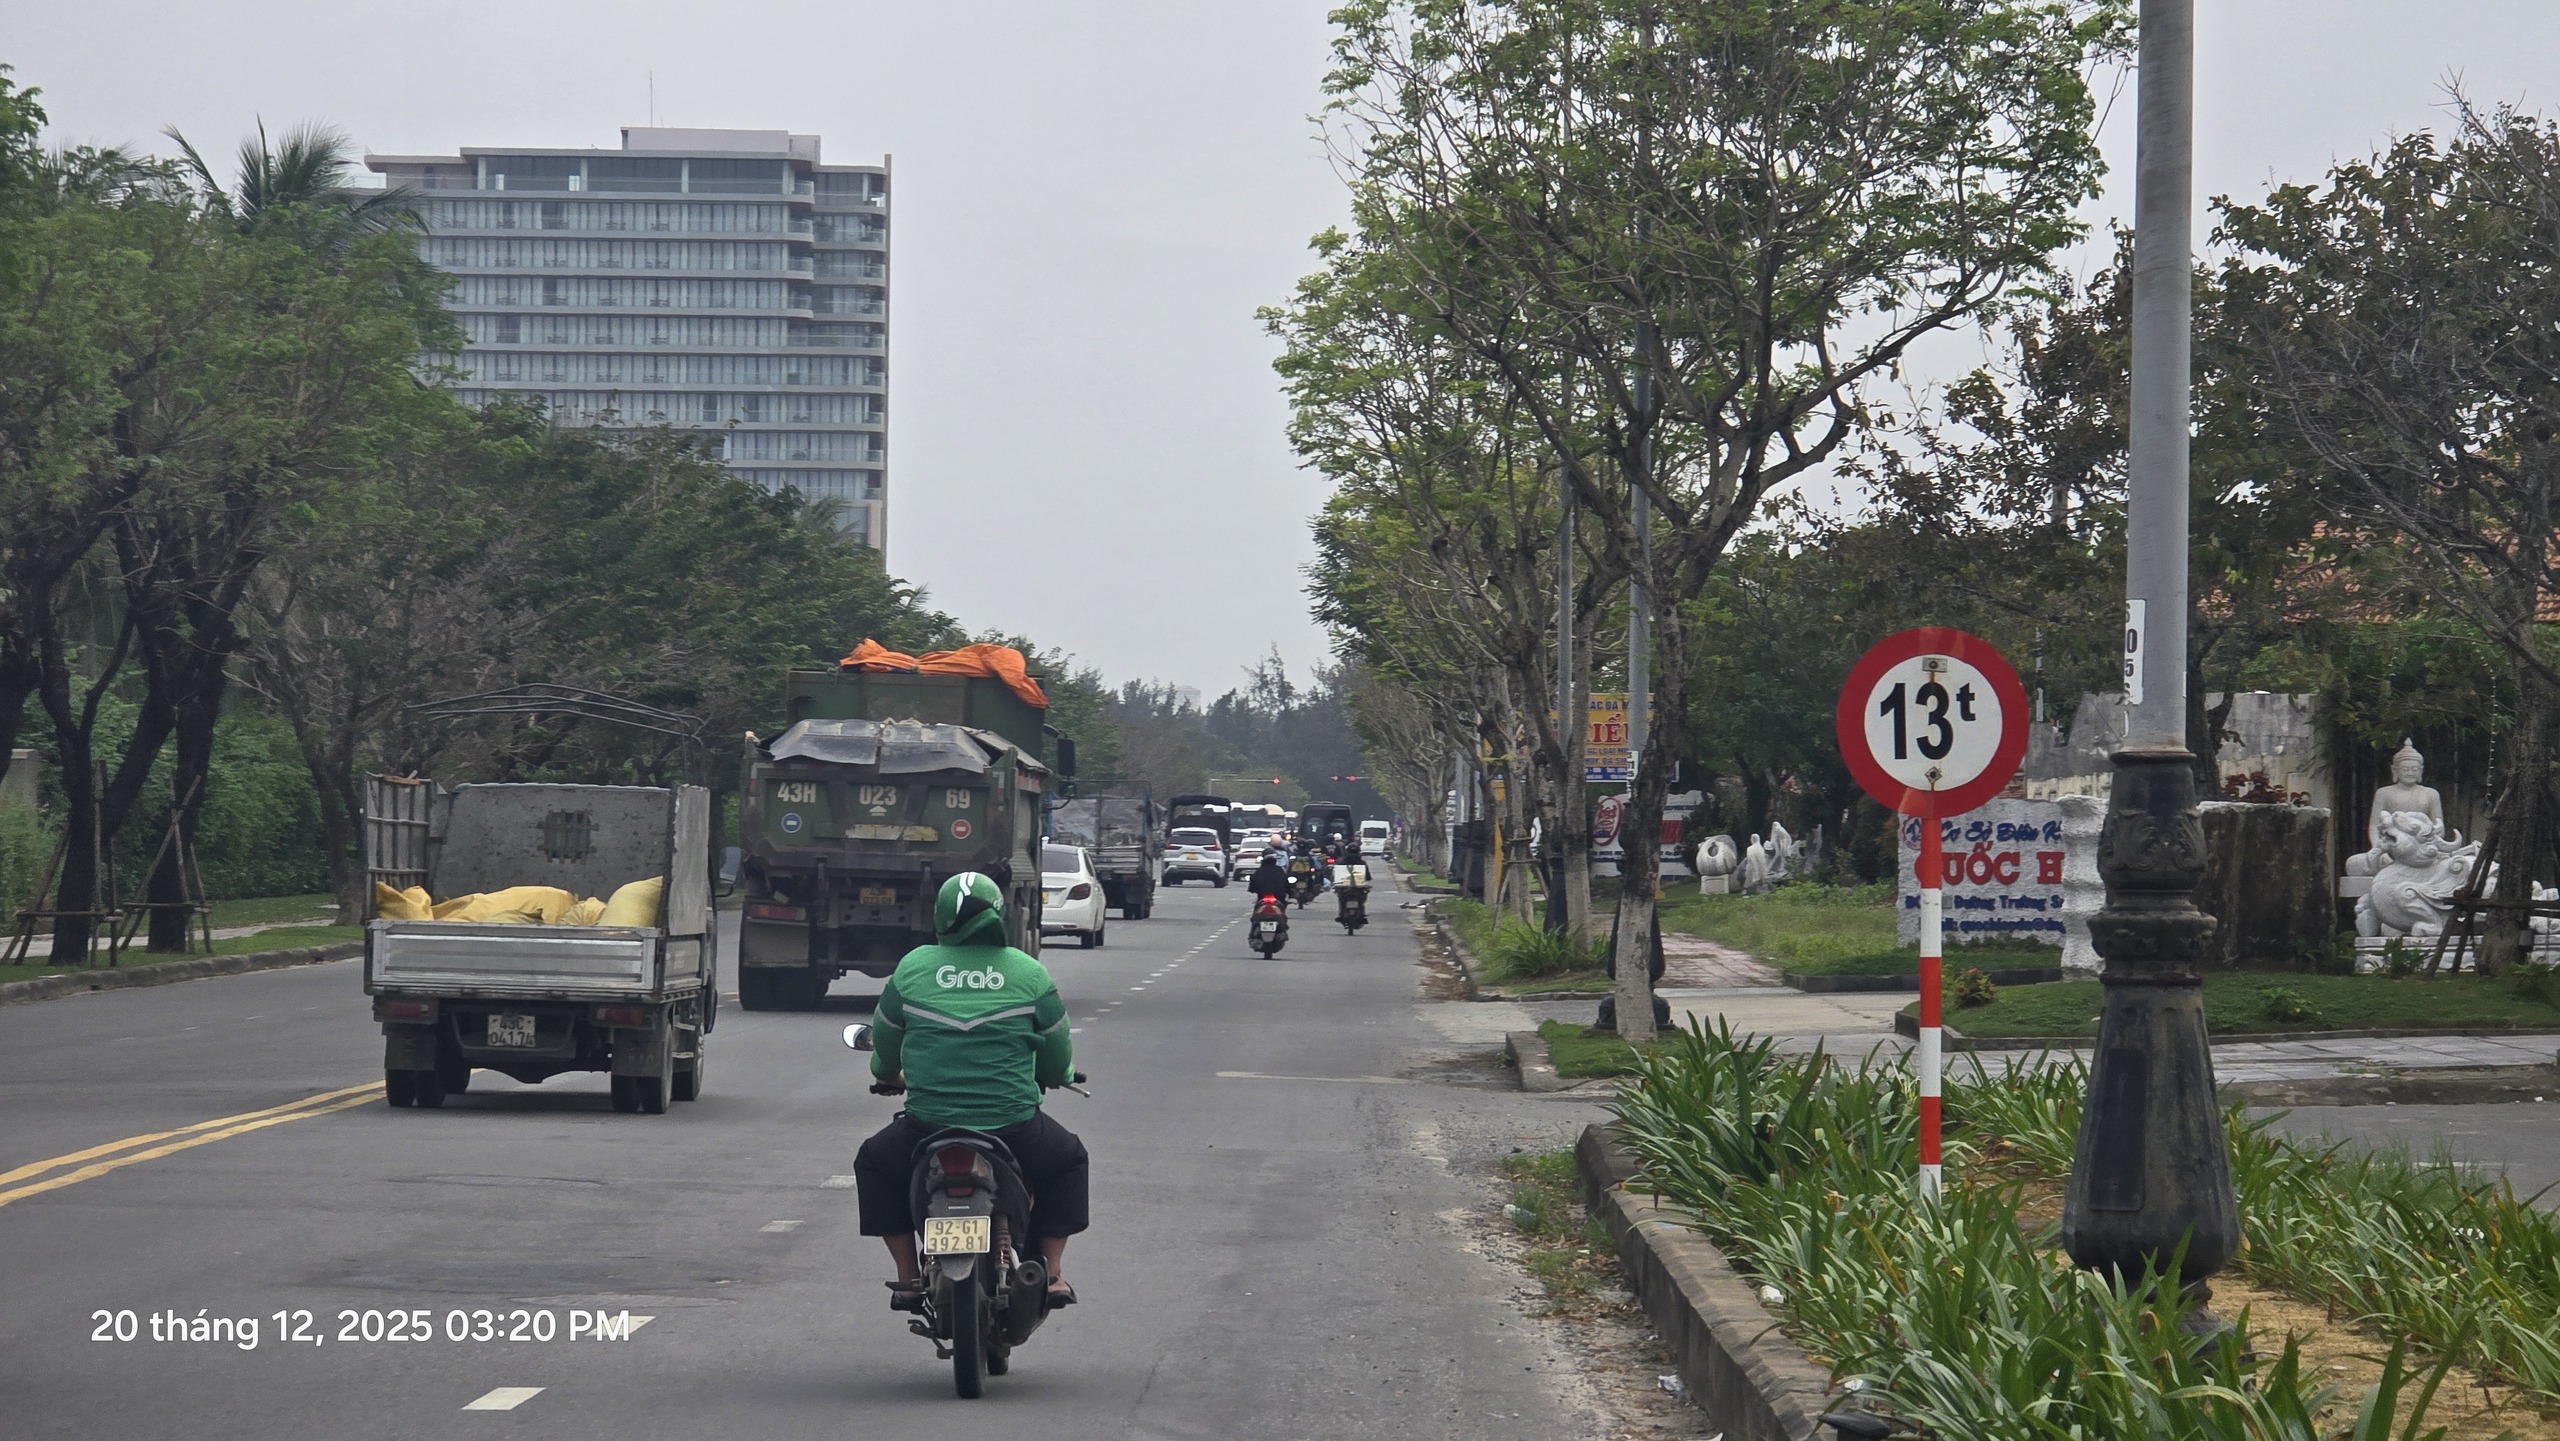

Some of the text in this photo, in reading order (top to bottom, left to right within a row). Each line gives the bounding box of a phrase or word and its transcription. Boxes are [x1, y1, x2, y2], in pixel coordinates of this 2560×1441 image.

[777, 782, 971, 809] 43H 023 69
[2036, 851, 2066, 885] H
[936, 965, 1005, 990] Grab
[935, 1220, 978, 1236] 92-G1
[928, 1236, 984, 1252] 392.81
